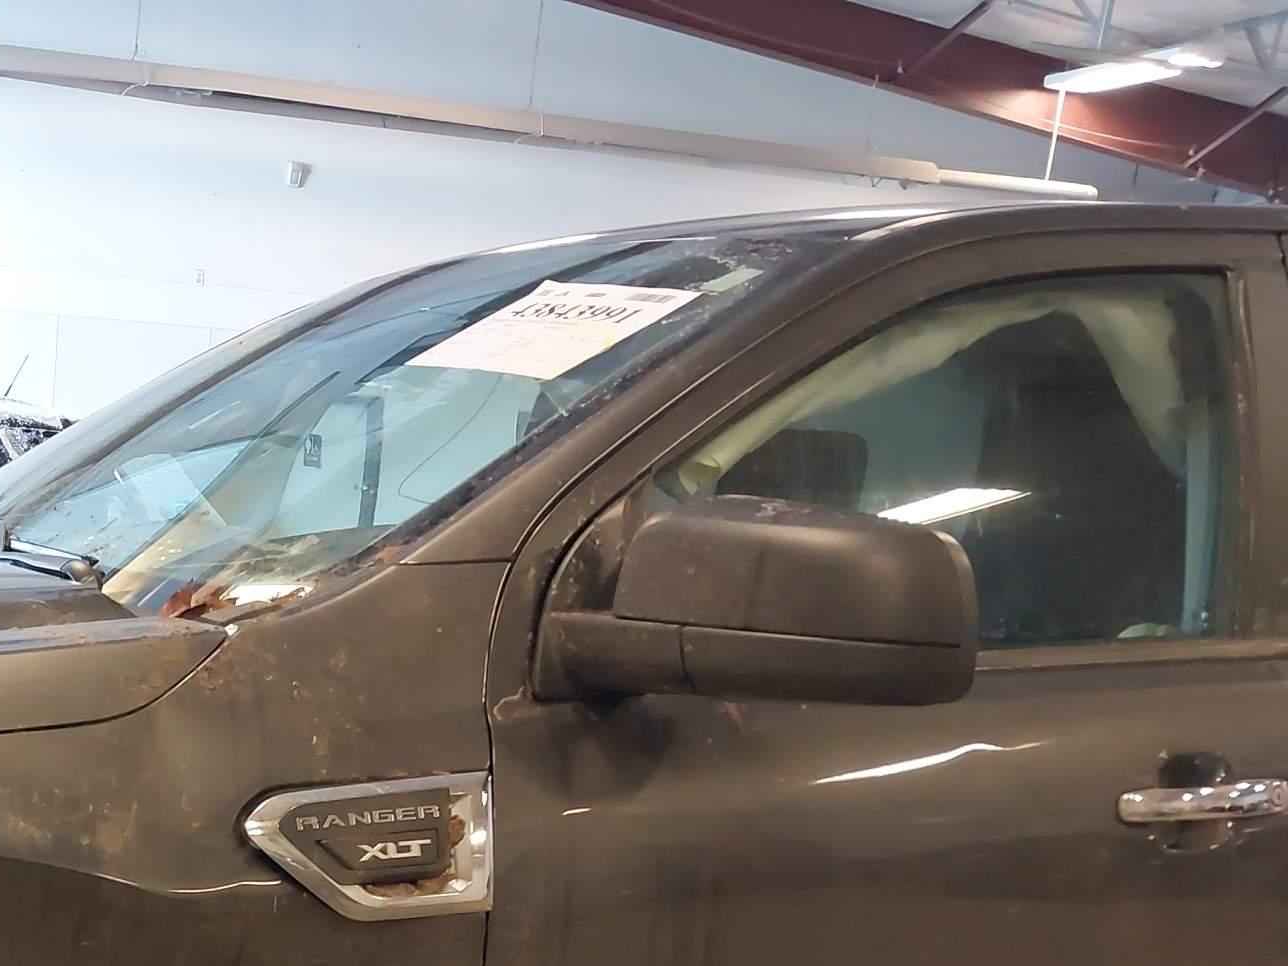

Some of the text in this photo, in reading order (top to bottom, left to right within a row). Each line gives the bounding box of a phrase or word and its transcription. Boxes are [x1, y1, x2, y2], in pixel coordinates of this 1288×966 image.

[512, 303, 643, 323] 43843991
[295, 805, 441, 831] RANGER
[356, 839, 432, 863] XLT
